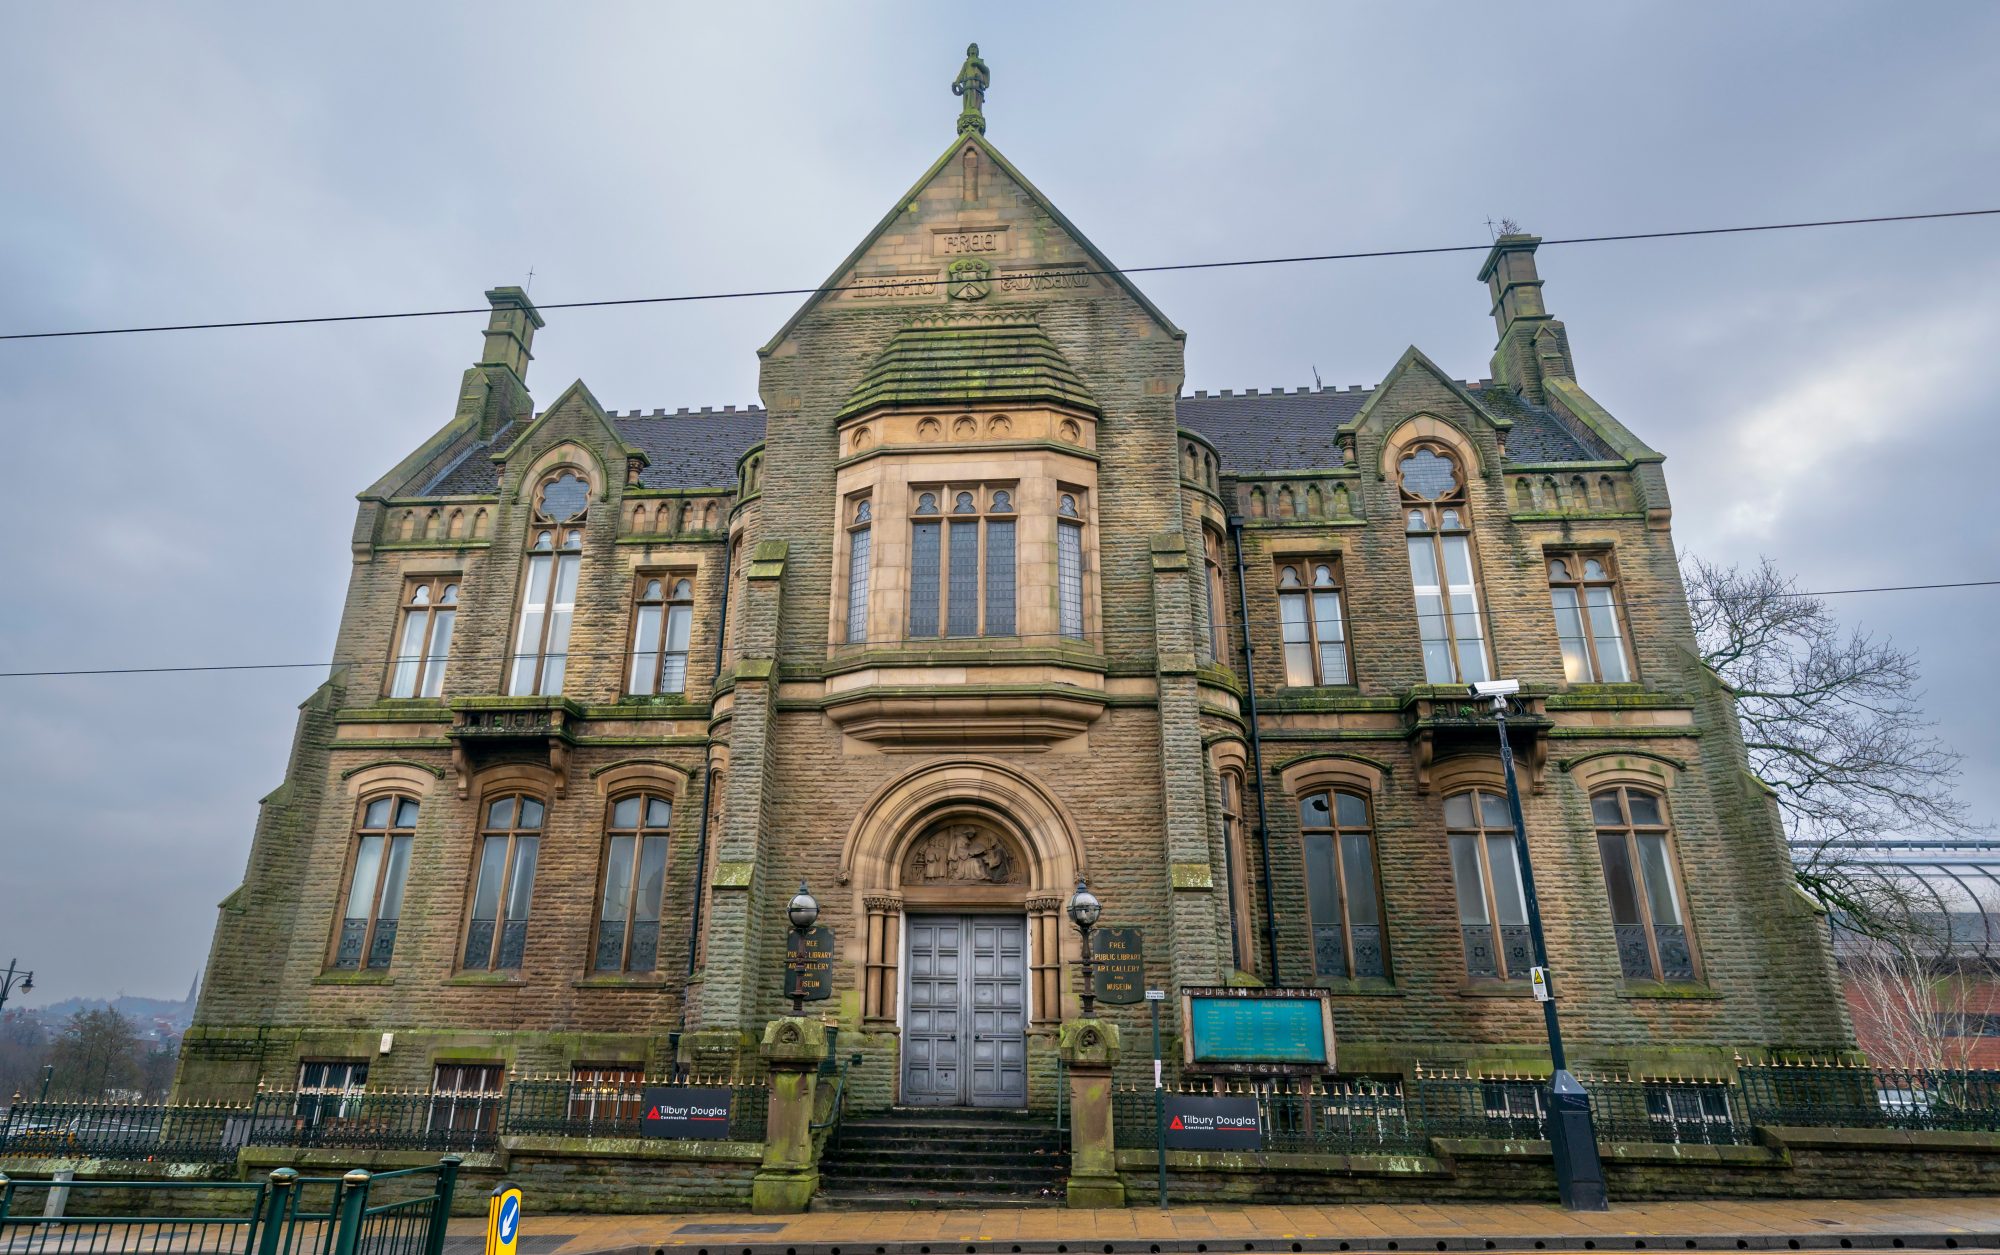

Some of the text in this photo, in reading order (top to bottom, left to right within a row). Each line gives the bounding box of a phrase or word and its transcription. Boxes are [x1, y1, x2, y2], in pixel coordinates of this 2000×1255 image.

[1094, 953, 1116, 961] PUBLIC
[1107, 983, 1132, 991] MUSEUM
[660, 1105, 727, 1117] Tilbury Douglas
[1183, 1115, 1256, 1127] Tilbury Douglas
